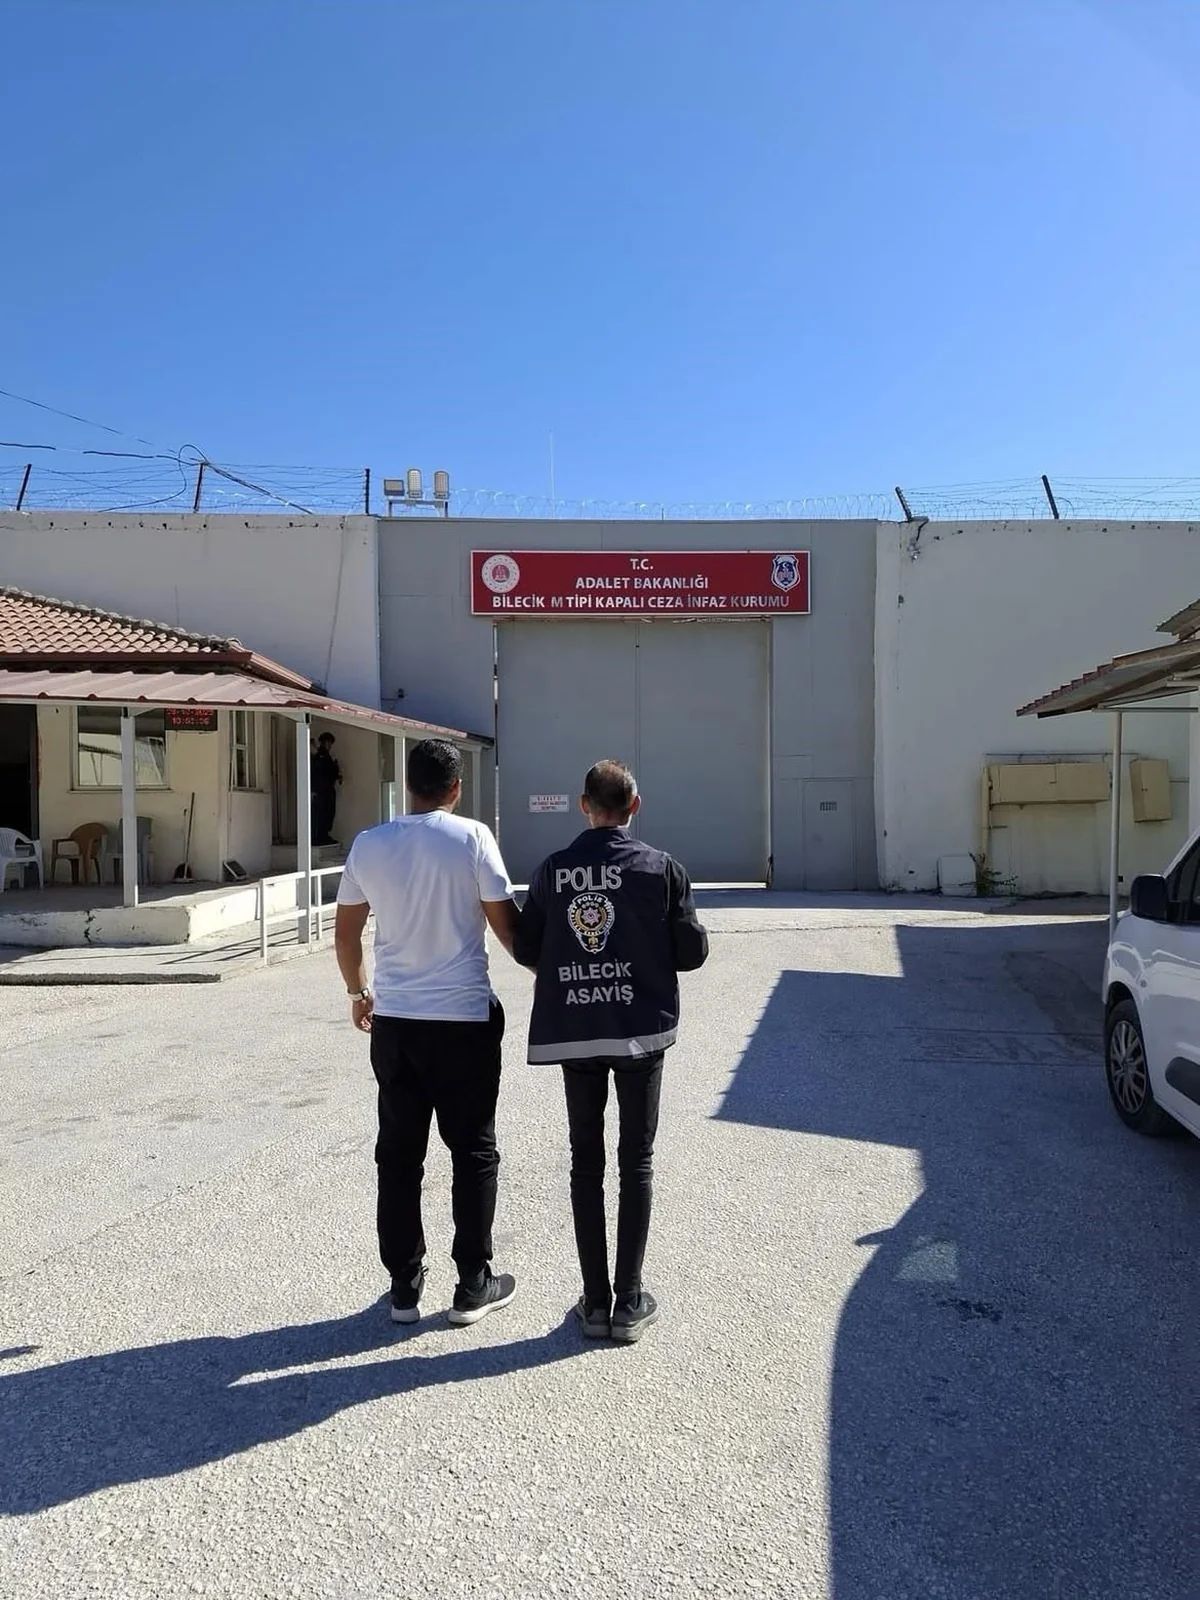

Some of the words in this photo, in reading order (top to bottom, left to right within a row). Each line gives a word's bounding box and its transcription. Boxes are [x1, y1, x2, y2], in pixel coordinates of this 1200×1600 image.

[630, 558, 654, 570] T.C.
[575, 577, 630, 589] ADALET
[633, 574, 708, 589] BAKANLIĞI
[492, 593, 545, 608] BİLECİK
[551, 596, 563, 608] M
[565, 593, 592, 608] TİPİ
[595, 595, 644, 608] KAPALI
[648, 595, 684, 608] CEZA
[687, 593, 728, 608] İNFAZ
[730, 595, 789, 608] KURUMU
[558, 958, 633, 982] BİLECİK
[565, 981, 634, 1005] ASAYİŞ
